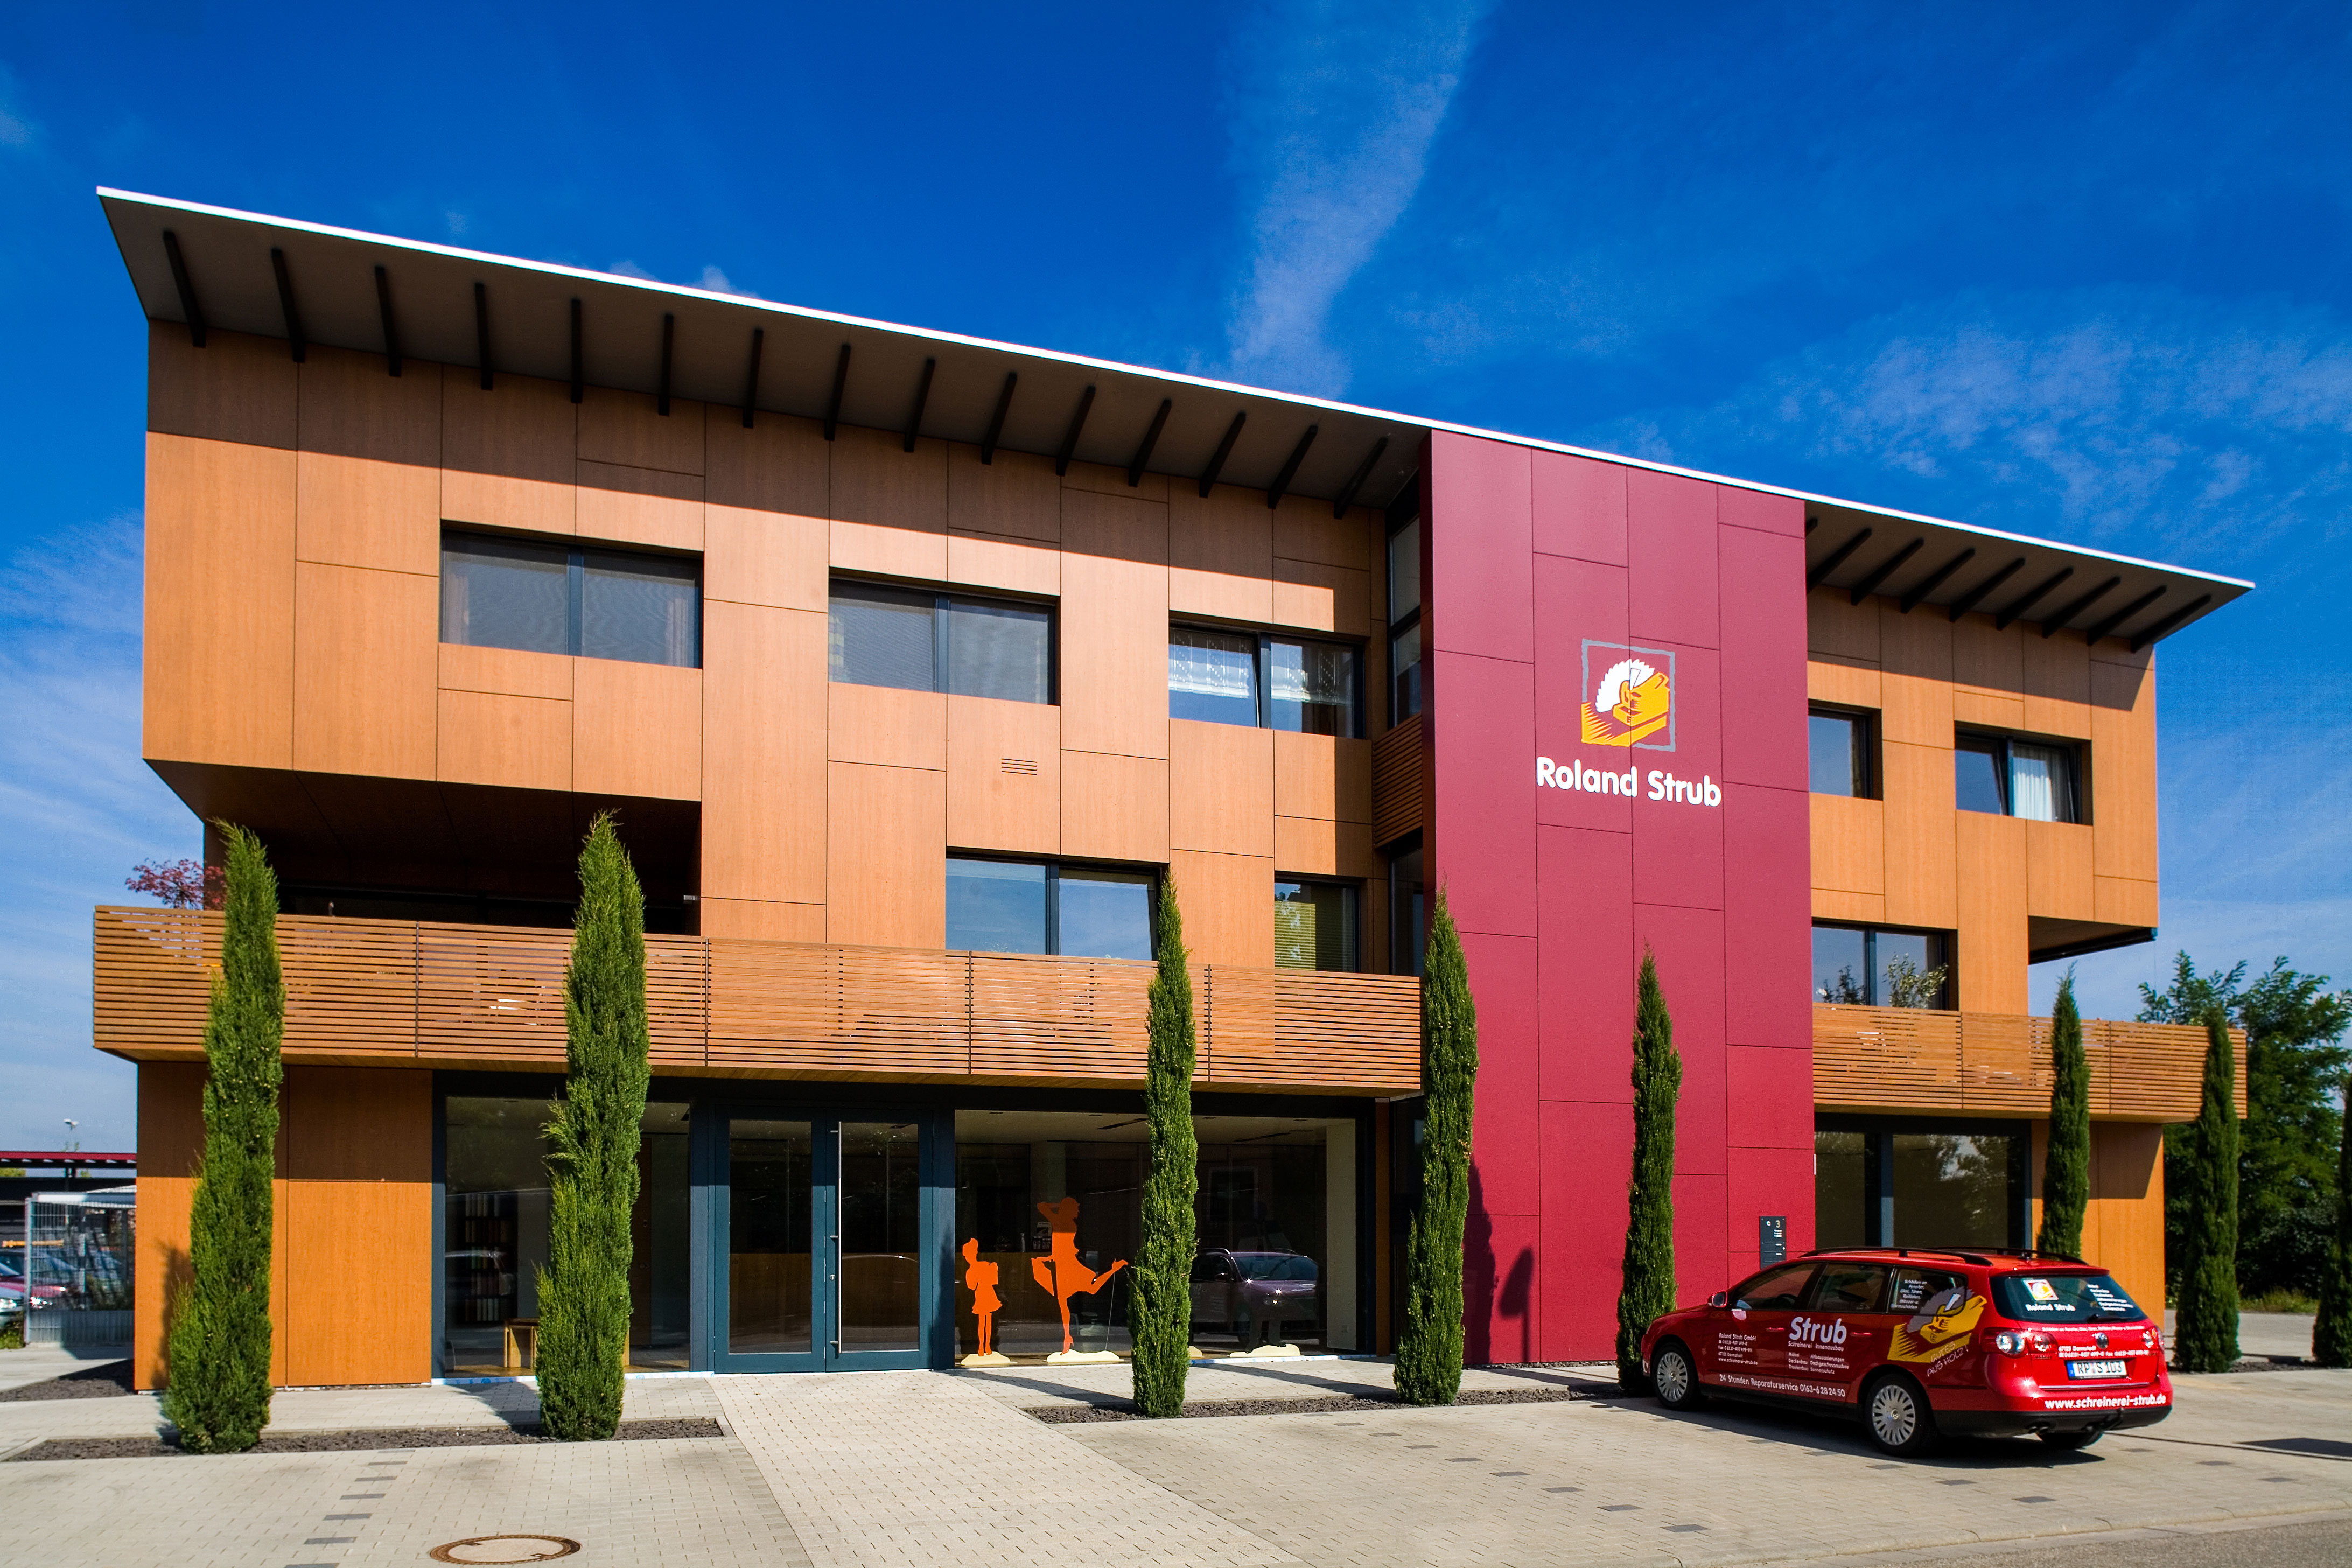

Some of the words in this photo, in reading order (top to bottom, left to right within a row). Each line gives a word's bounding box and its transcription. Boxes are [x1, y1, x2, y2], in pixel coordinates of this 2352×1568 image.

[1537, 757, 1638, 798] Roland
[1648, 770, 1723, 808] Strub
[1775, 1220, 1781, 1228] 3
[2025, 1303, 2054, 1311] Roland
[2054, 1303, 2076, 1311] Strub
[1789, 1317, 1847, 1345] Strub
[1815, 1343, 1844, 1352] Innenausbau
[1931, 1341, 1955, 1362] GUTES
[1718, 1357, 1758, 1366] www.schreinerei-strub.de
[1927, 1361, 1943, 1377] AUS
[2077, 1362, 2090, 1374] RP
[2104, 1361, 2122, 1373] 103
[1719, 1374, 1727, 1382] 24
[1727, 1375, 1749, 1385] Stunden
[1751, 1377, 1798, 1392] Reparaturservice
[2044, 1392, 2166, 1409] www.schreinerei-strub.de
